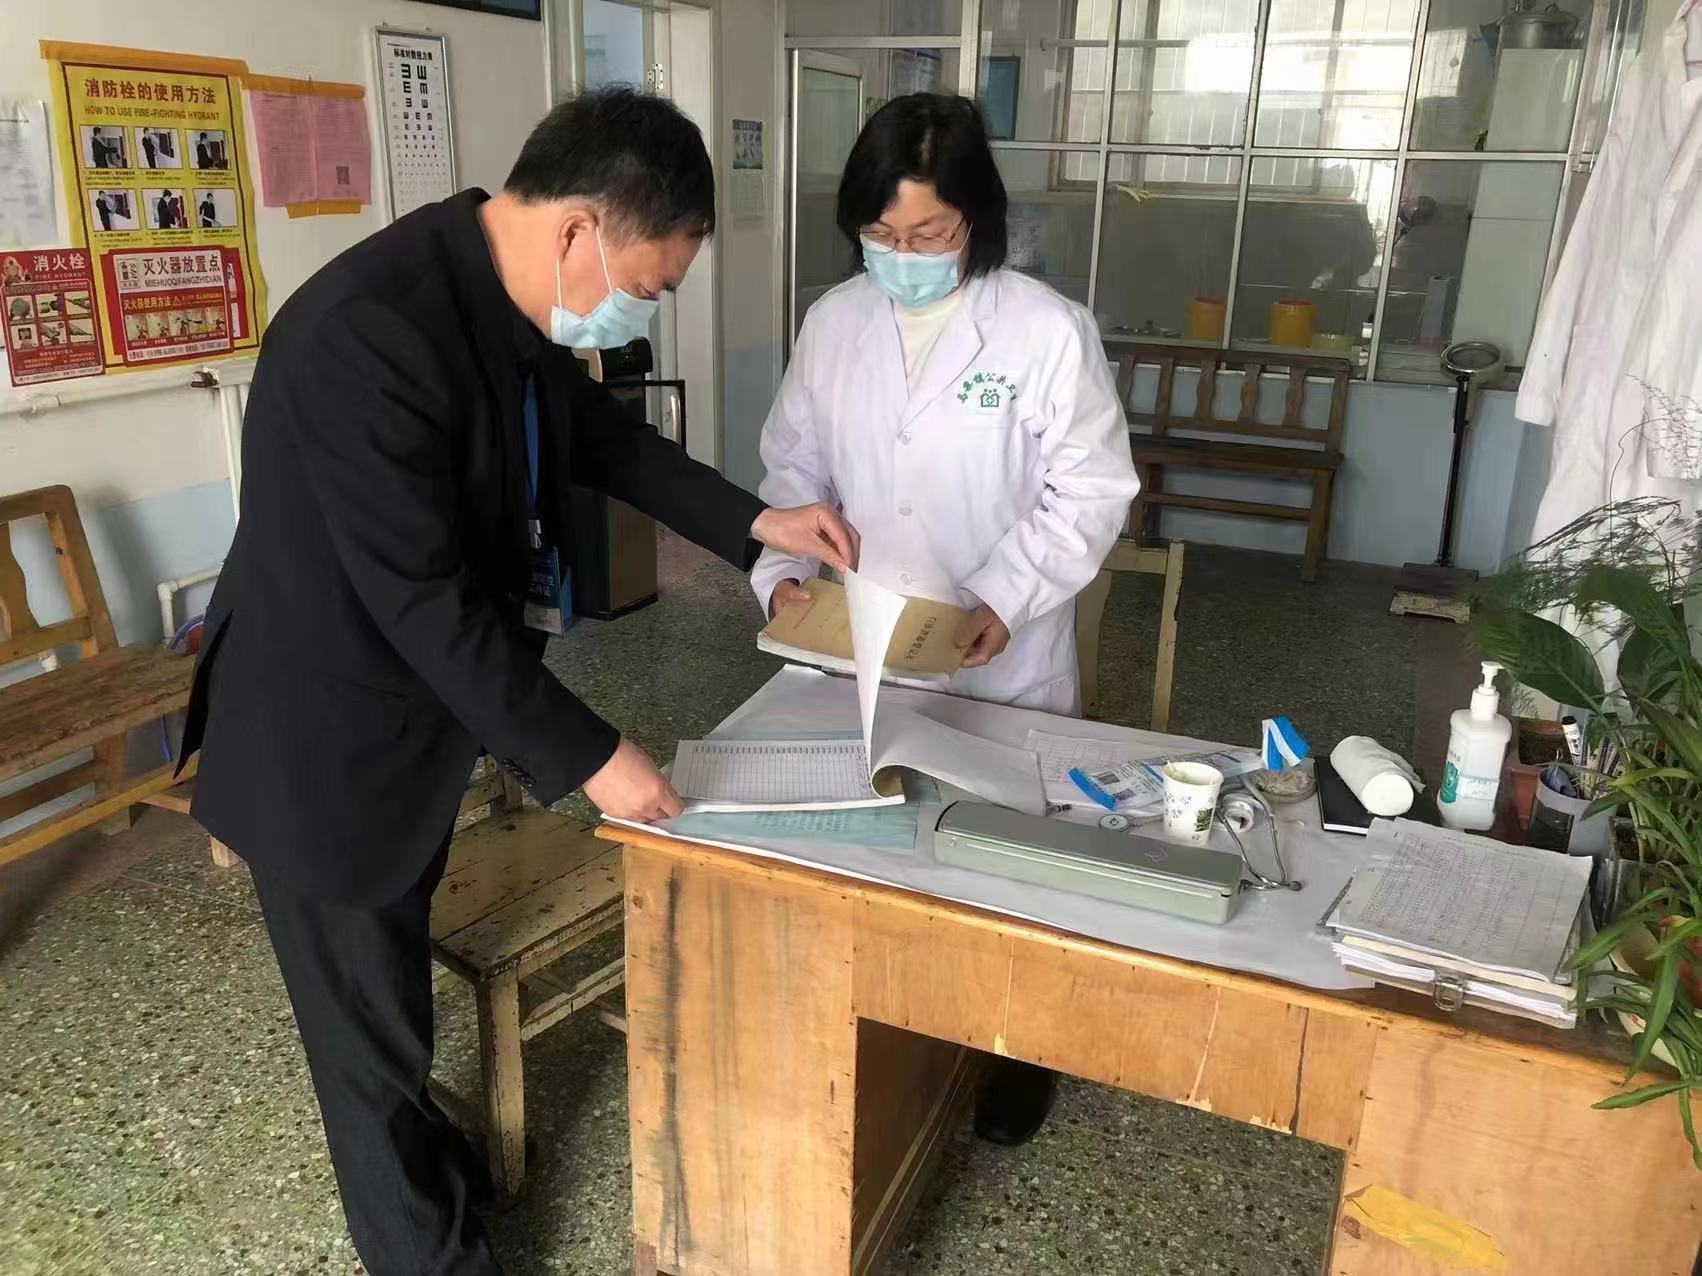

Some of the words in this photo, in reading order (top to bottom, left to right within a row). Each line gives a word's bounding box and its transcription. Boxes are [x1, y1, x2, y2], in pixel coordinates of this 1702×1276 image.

[84, 78, 216, 104] 消防栓的使用方法
[84, 105, 102, 116] HOW
[104, 106, 115, 116] TO
[118, 107, 133, 117] USE
[134, 107, 186, 120] FIRE-FIGHTING
[188, 111, 220, 121] HYDRANT
[33, 253, 86, 272] 消火栓
[142, 254, 220, 276] 灭火器放置点
[123, 295, 171, 310] 灭火器使用方法
